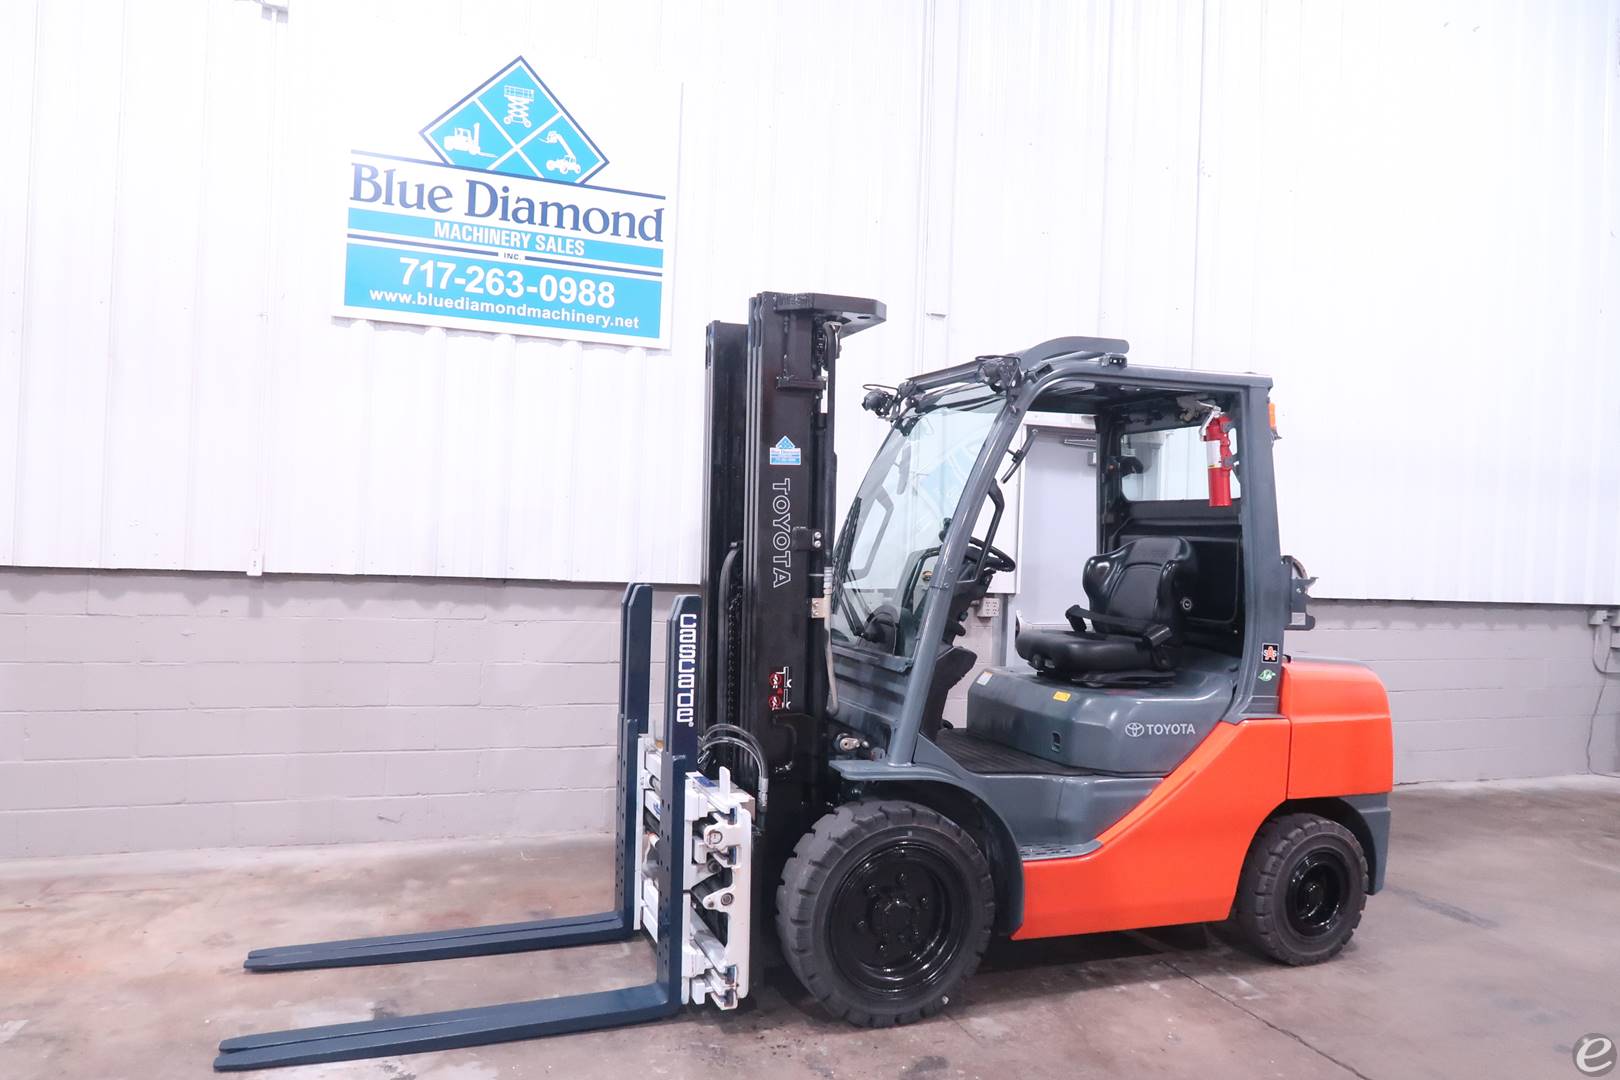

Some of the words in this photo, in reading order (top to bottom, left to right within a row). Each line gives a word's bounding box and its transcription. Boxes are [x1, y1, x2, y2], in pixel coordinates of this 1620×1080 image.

[349, 162, 453, 213] Blue
[464, 179, 665, 243] Diamond
[434, 220, 533, 250] MACHINERY
[535, 235, 585, 257] SALES
[399, 257, 616, 309] 717-263-0988
[369, 287, 640, 330] www.bluediamondmachinery.net
[772, 477, 792, 588] TOYOTA
[1146, 723, 1196, 736] TOYOTA
